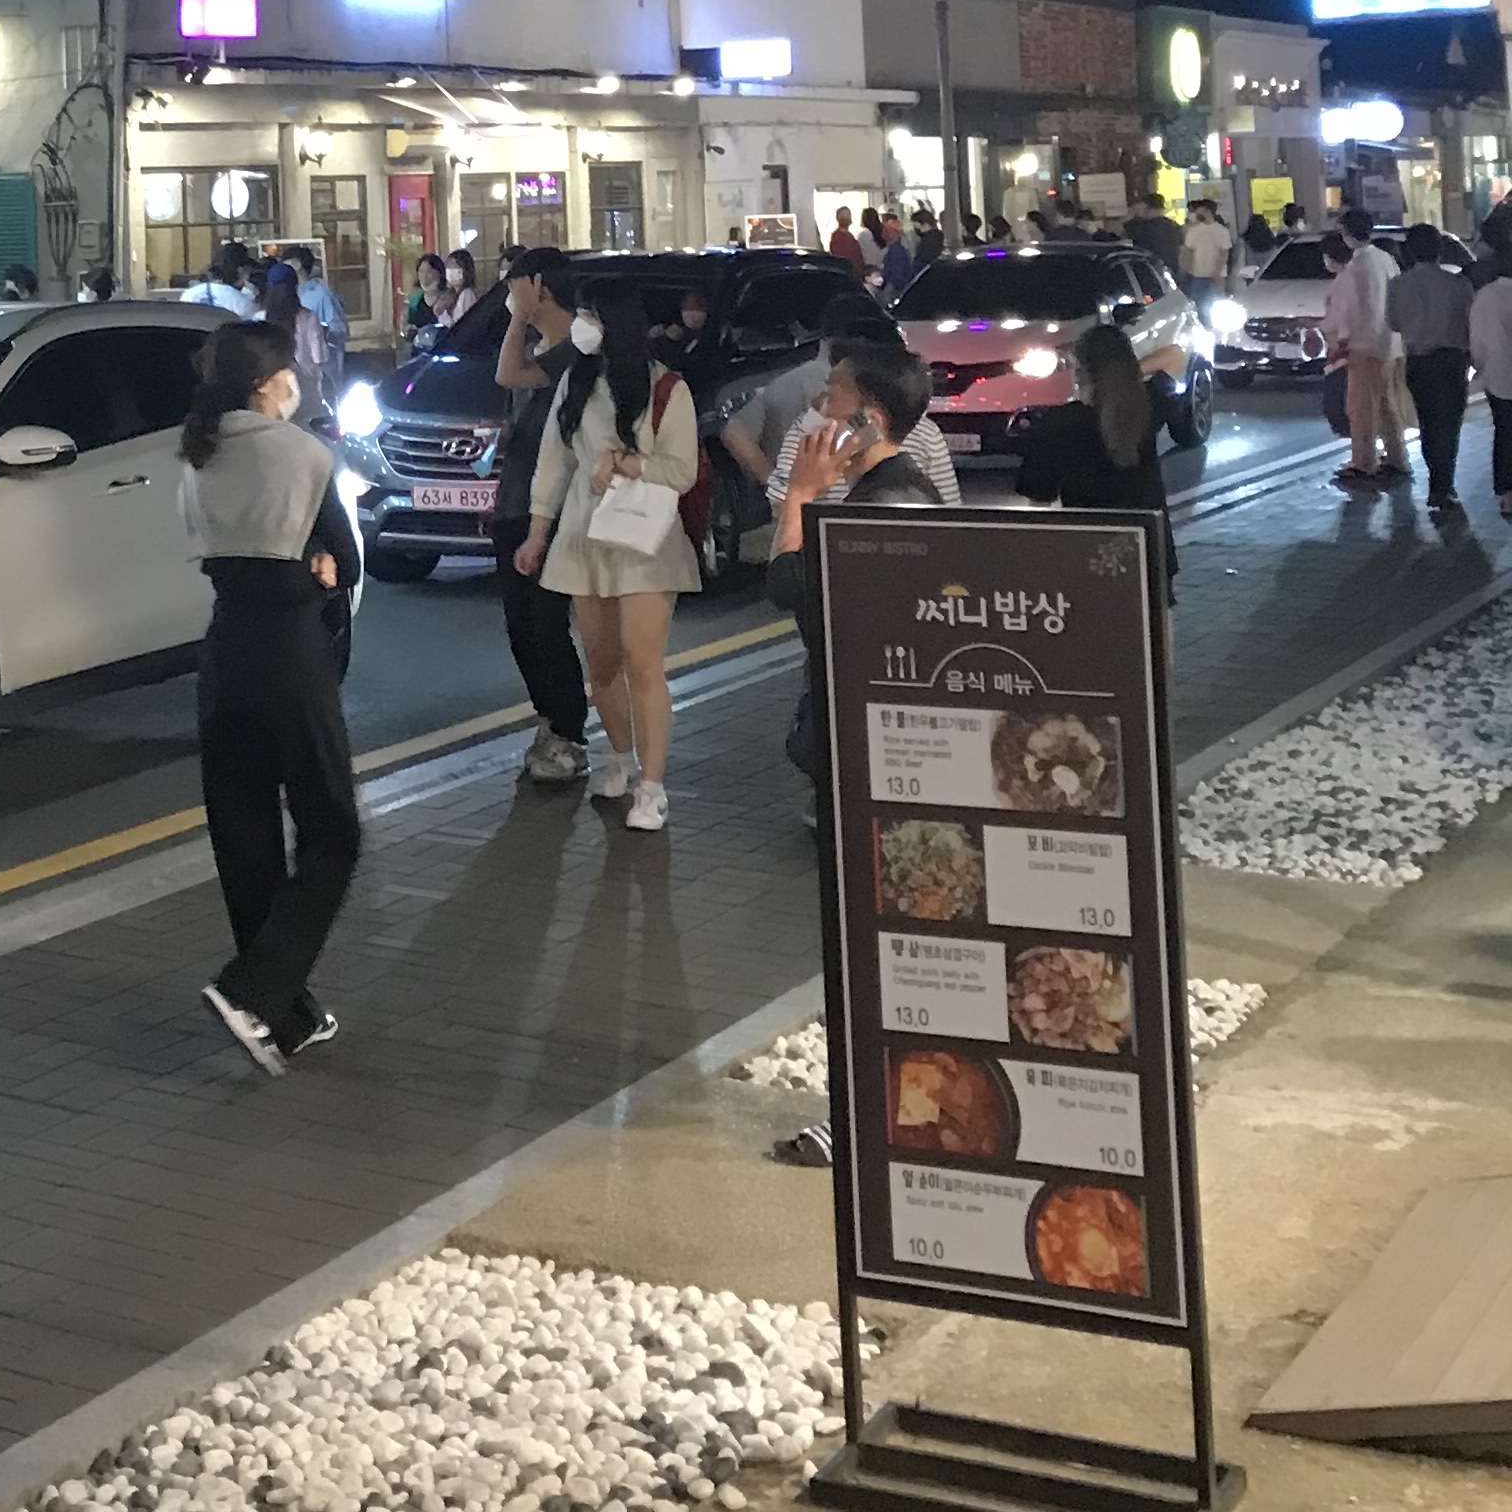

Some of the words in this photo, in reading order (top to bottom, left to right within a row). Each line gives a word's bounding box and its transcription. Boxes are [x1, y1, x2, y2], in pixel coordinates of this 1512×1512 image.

[945, 669, 986, 693] 음식
[993, 672, 1035, 697] 메뉴
[887, 776, 920, 797] 13.0
[1079, 907, 1115, 929] 13.0
[896, 1006, 929, 1028] 13.0
[1099, 1146, 1137, 1169] 10.0
[909, 1238, 945, 1260] 10.0
